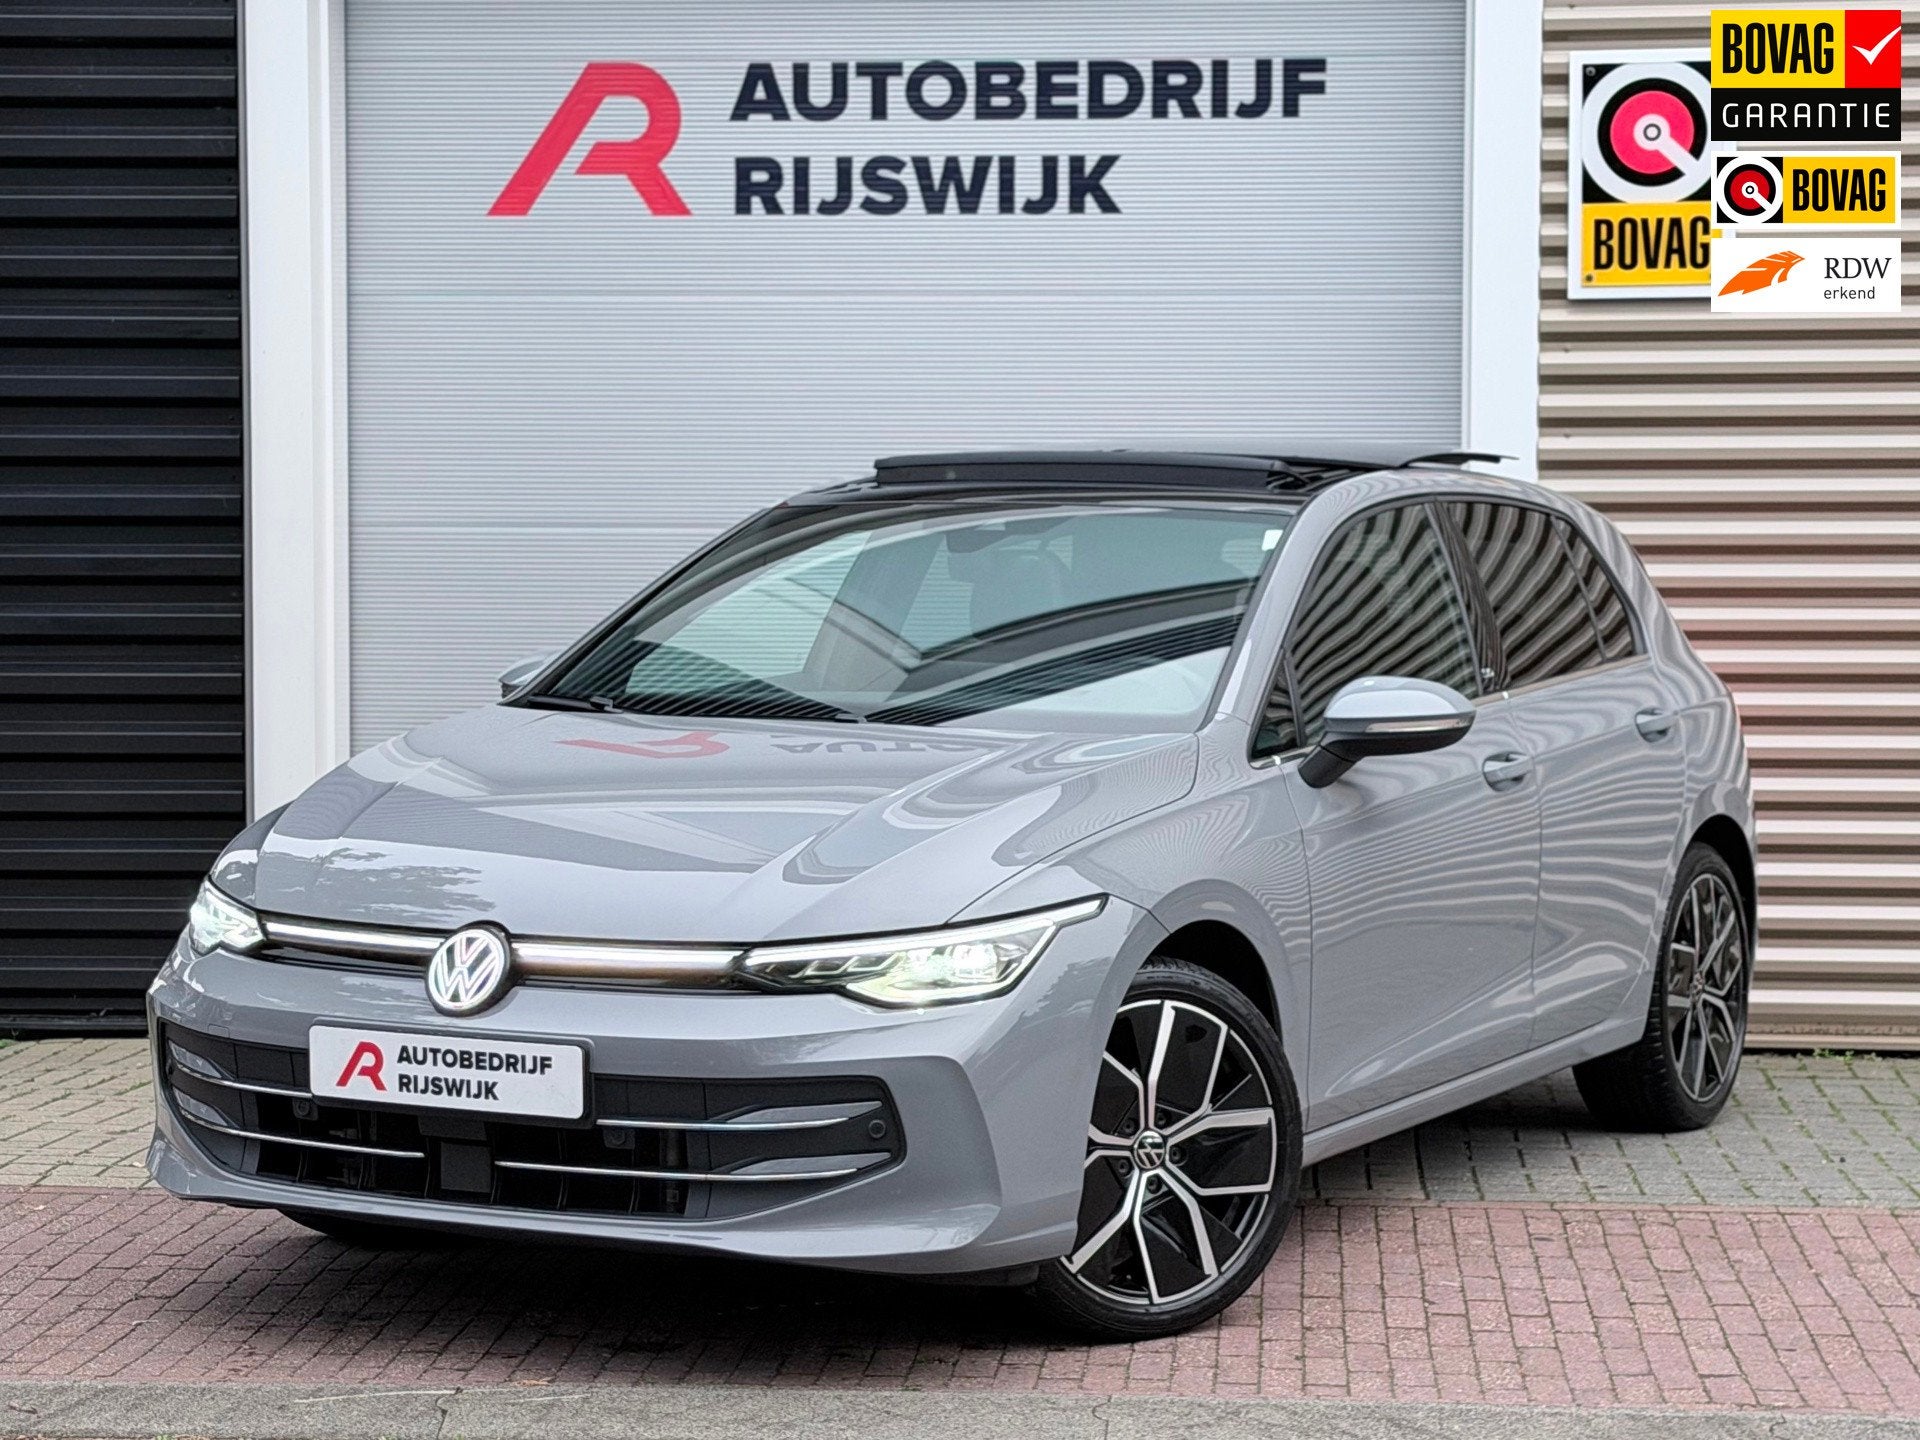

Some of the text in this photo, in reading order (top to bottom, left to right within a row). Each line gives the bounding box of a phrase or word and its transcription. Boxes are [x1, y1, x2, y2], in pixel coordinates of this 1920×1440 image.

[730, 58, 1327, 122] AUTOBEDRIJF
[733, 155, 1122, 215] RIJSWIJK
[1594, 216, 1710, 270] BOVAG
[397, 1044, 553, 1076] AUTOBEDRIJF
[398, 1074, 499, 1100] RIJSWIJK
